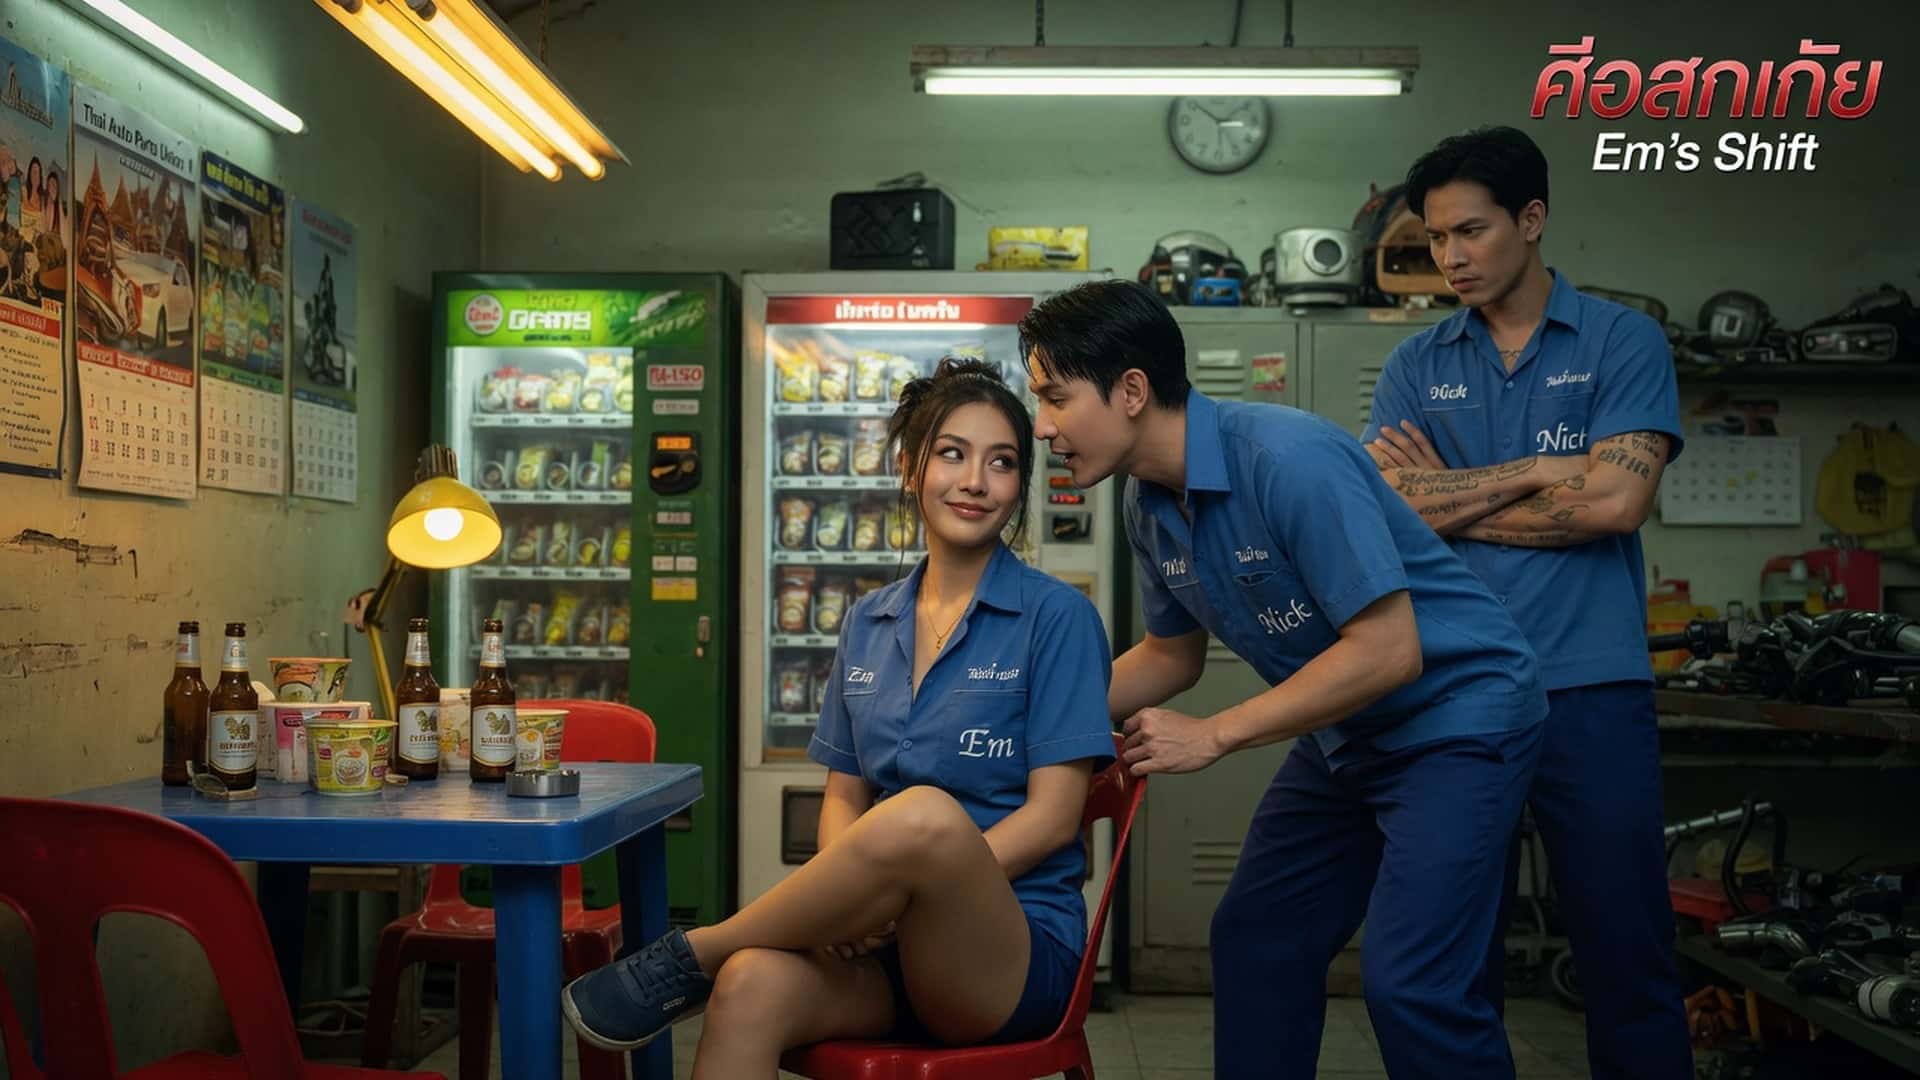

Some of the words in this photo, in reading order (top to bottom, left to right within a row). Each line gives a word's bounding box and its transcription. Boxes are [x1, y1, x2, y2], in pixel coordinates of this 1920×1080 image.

[83, 103, 107, 130] Thai
[108, 117, 133, 143] Auto
[1257, 598, 1313, 635] Nick
[958, 728, 1016, 759] Em
